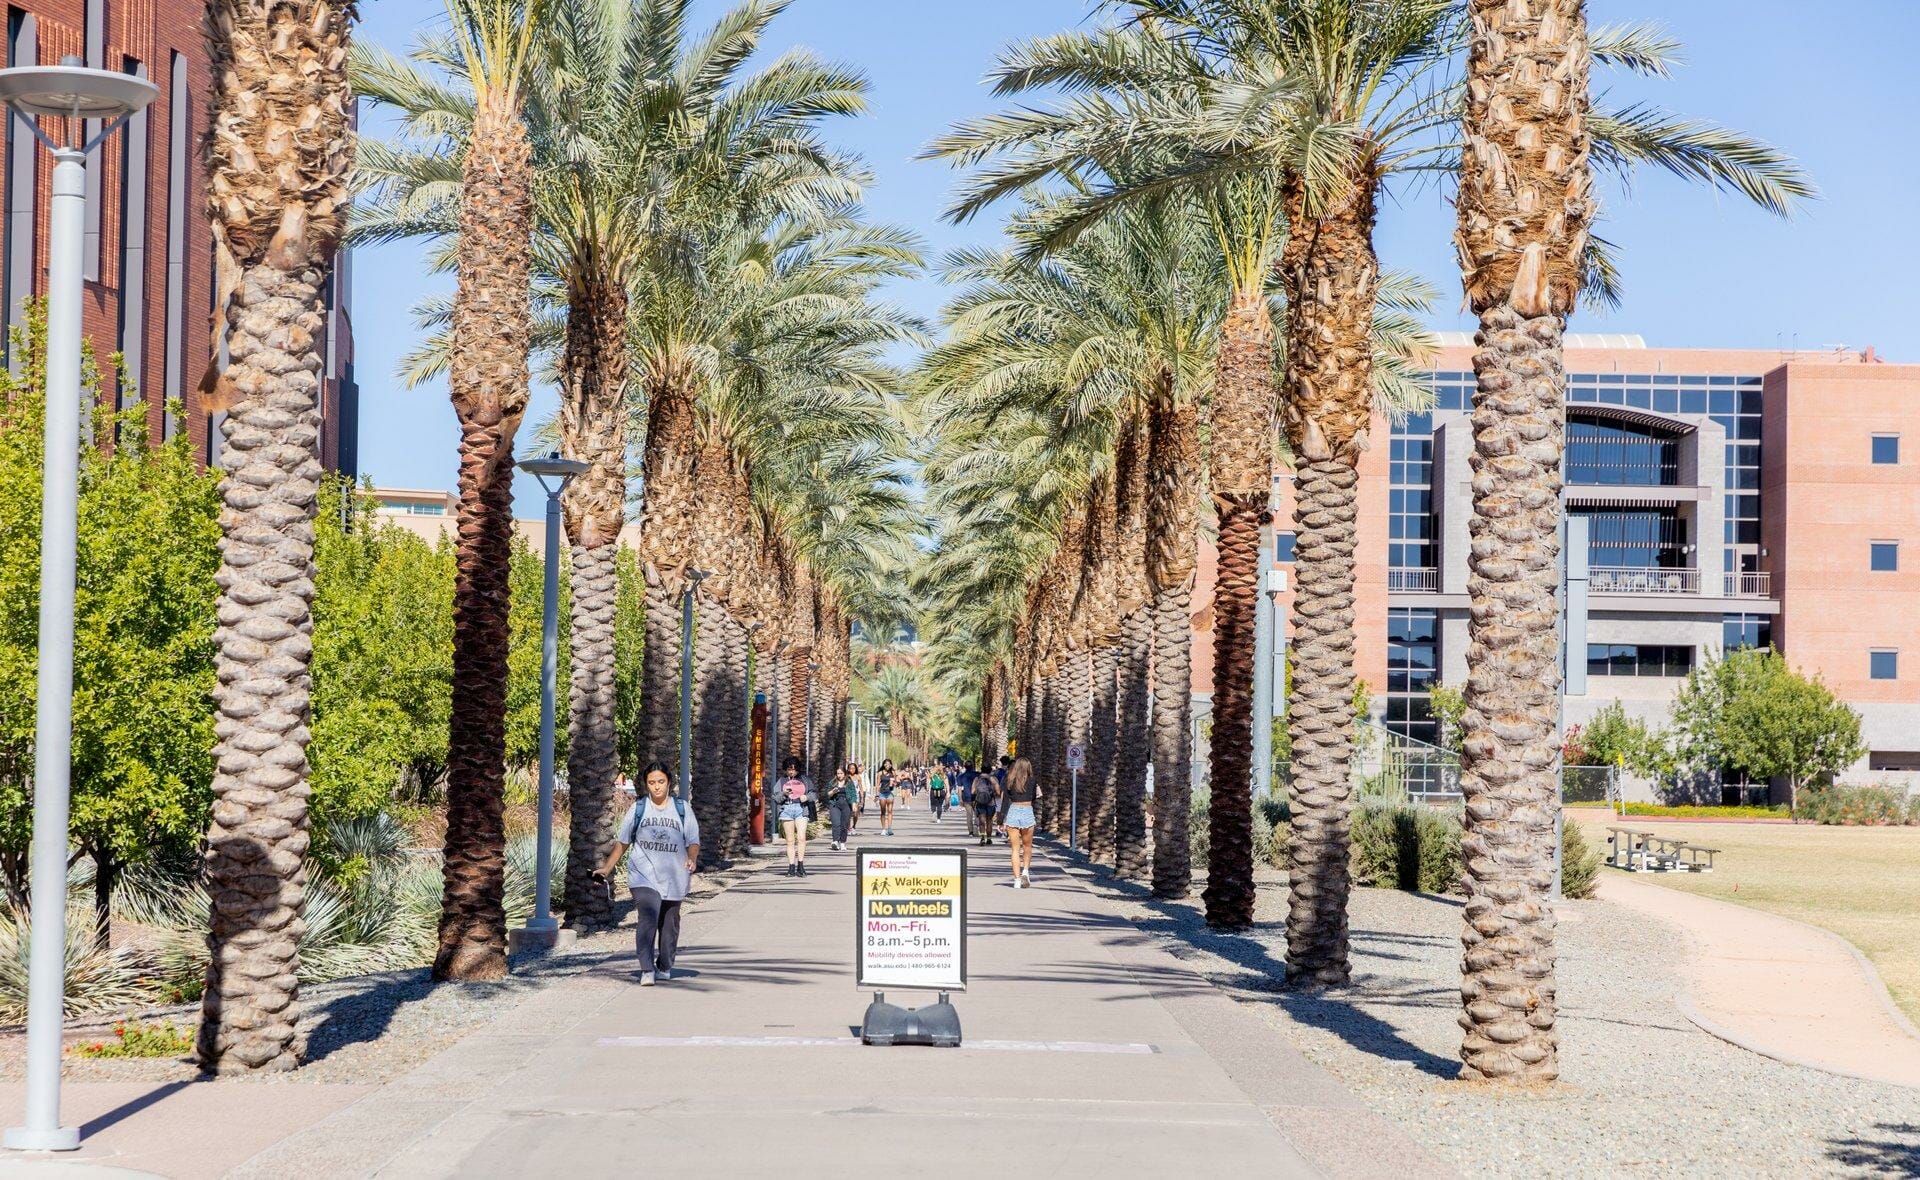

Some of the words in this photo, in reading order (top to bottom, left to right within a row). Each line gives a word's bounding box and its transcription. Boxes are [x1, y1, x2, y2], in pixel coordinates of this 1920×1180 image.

[640, 840, 679, 853] FOOTBALL
[869, 860, 887, 869] ASU
[895, 877, 949, 888] Walk-only
[871, 901, 893, 916] No
[895, 901, 949, 916] wheels
[868, 936, 875, 946] 8
[923, 938, 950, 949] p.m.
